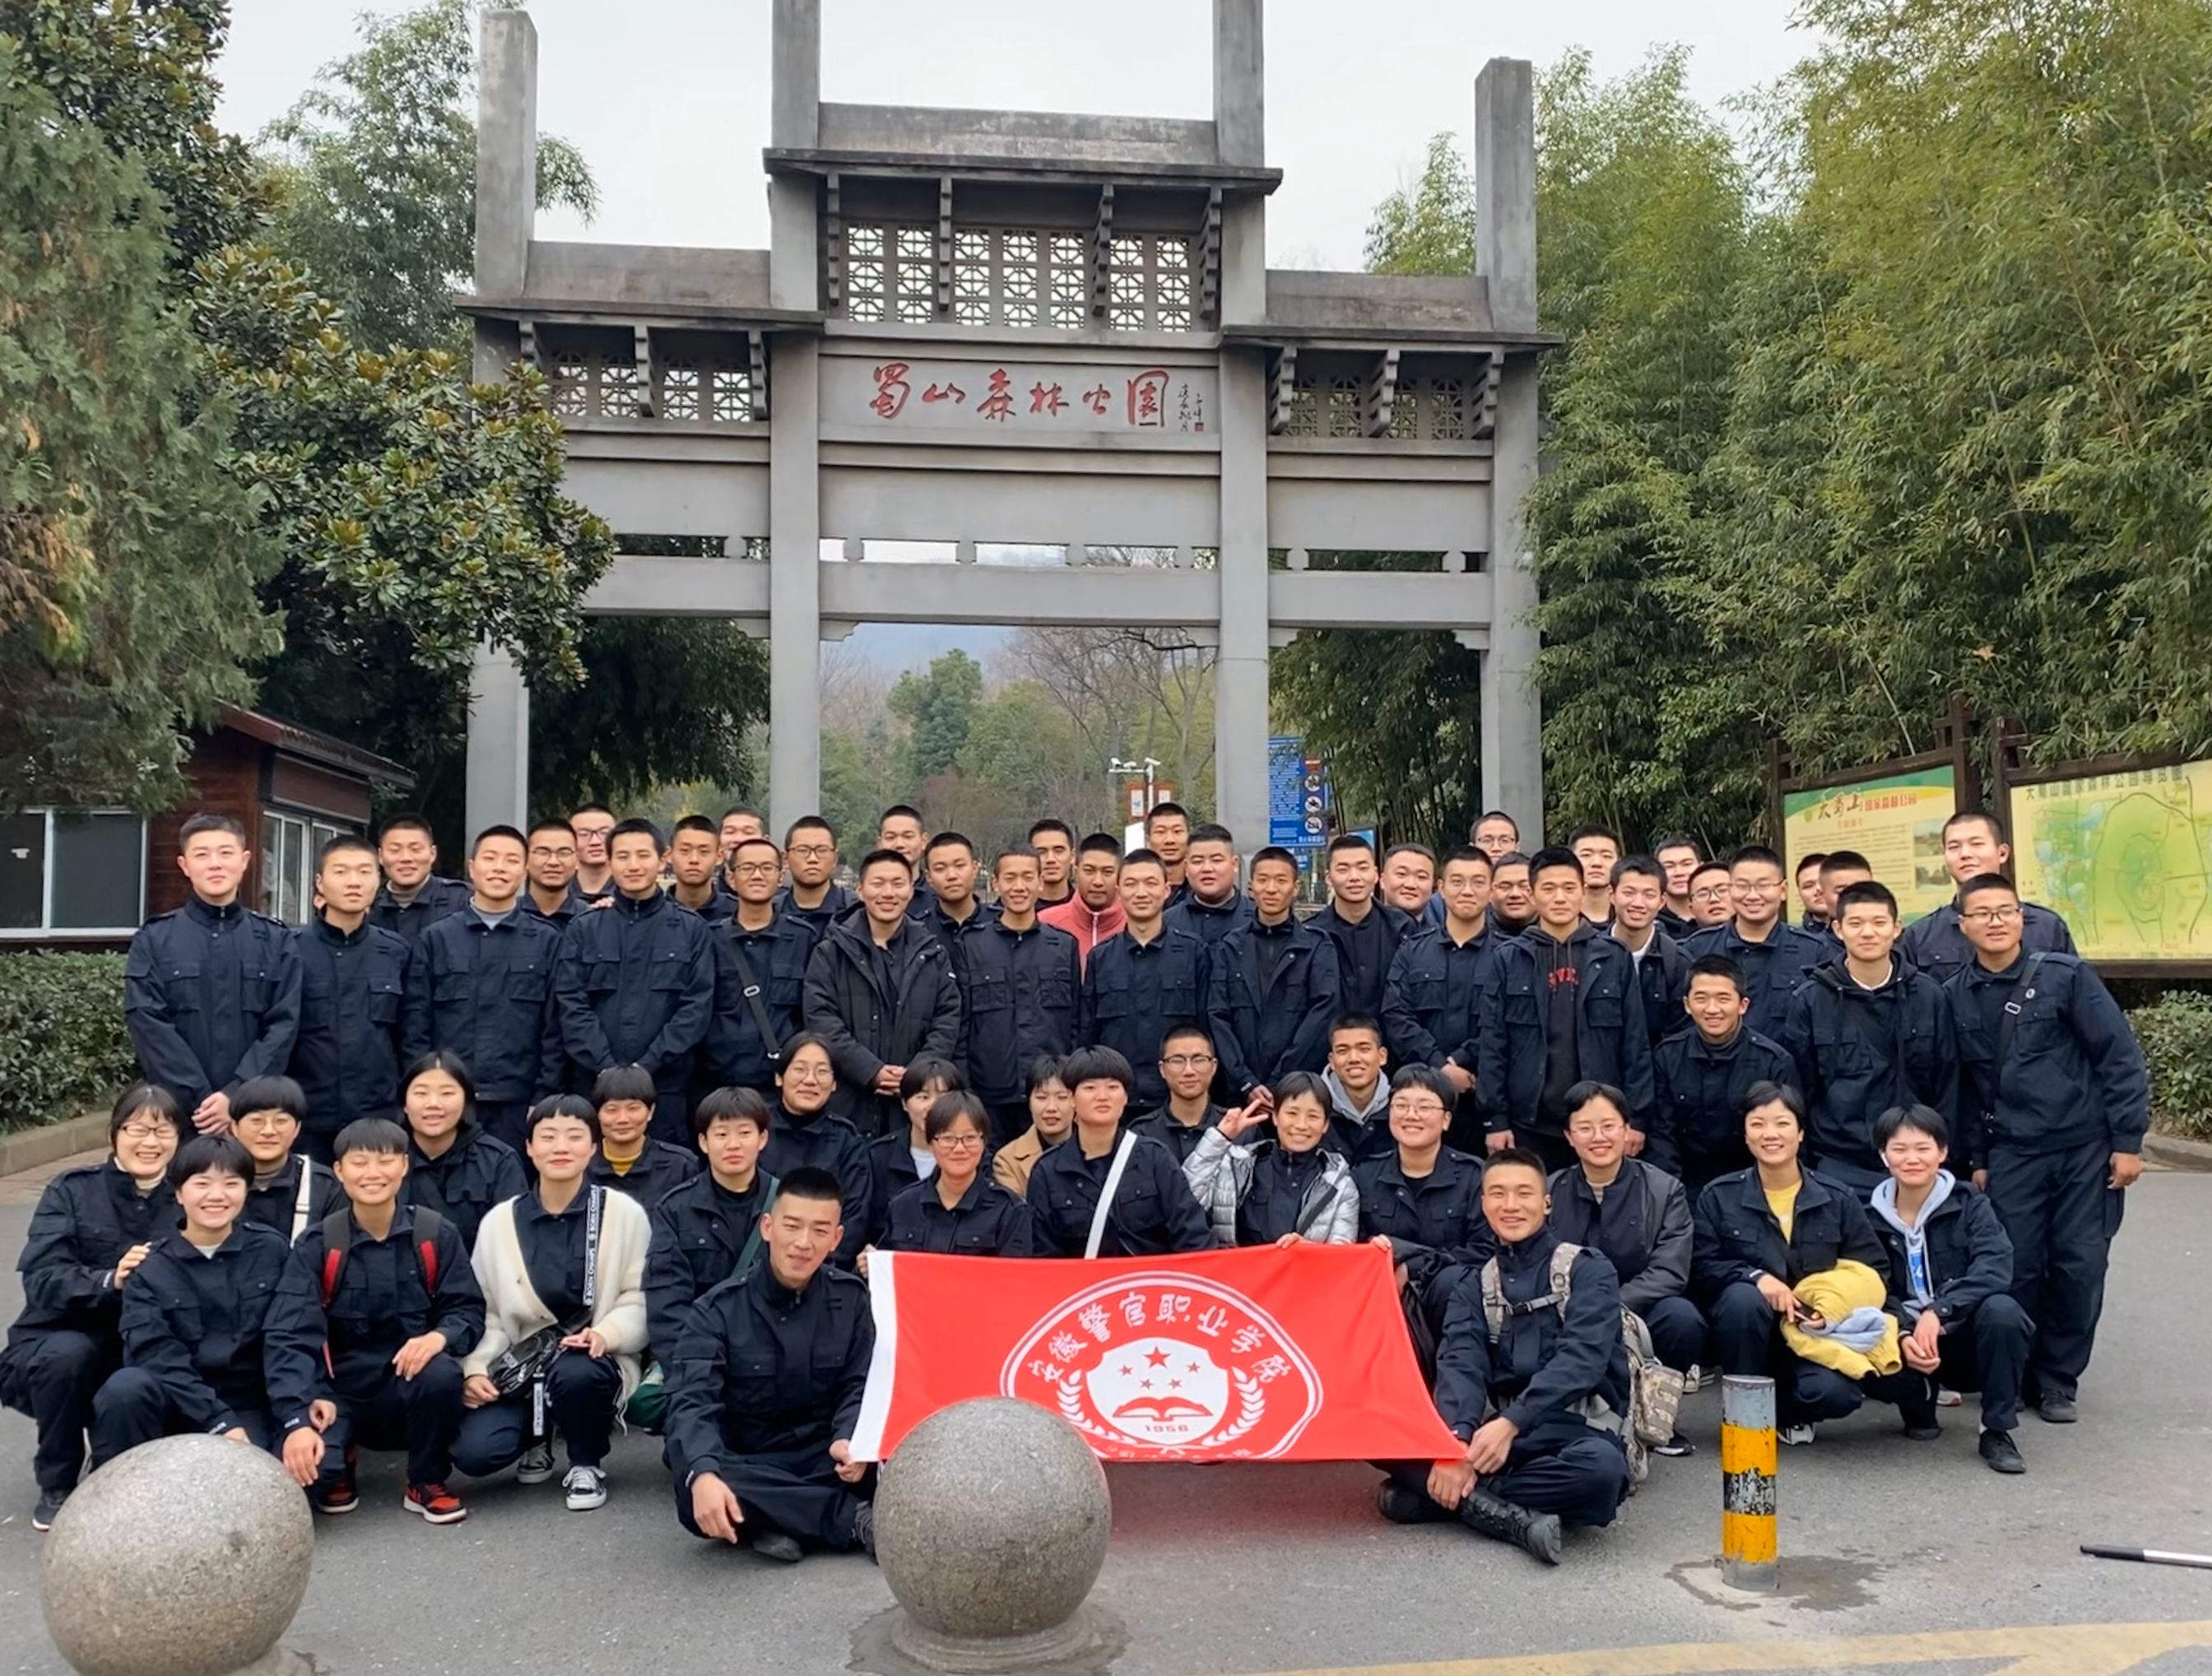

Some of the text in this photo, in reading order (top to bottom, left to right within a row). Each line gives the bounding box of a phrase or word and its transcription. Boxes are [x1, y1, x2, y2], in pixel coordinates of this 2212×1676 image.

[1028, 1291, 1292, 1383] 安徽警官职业学院
